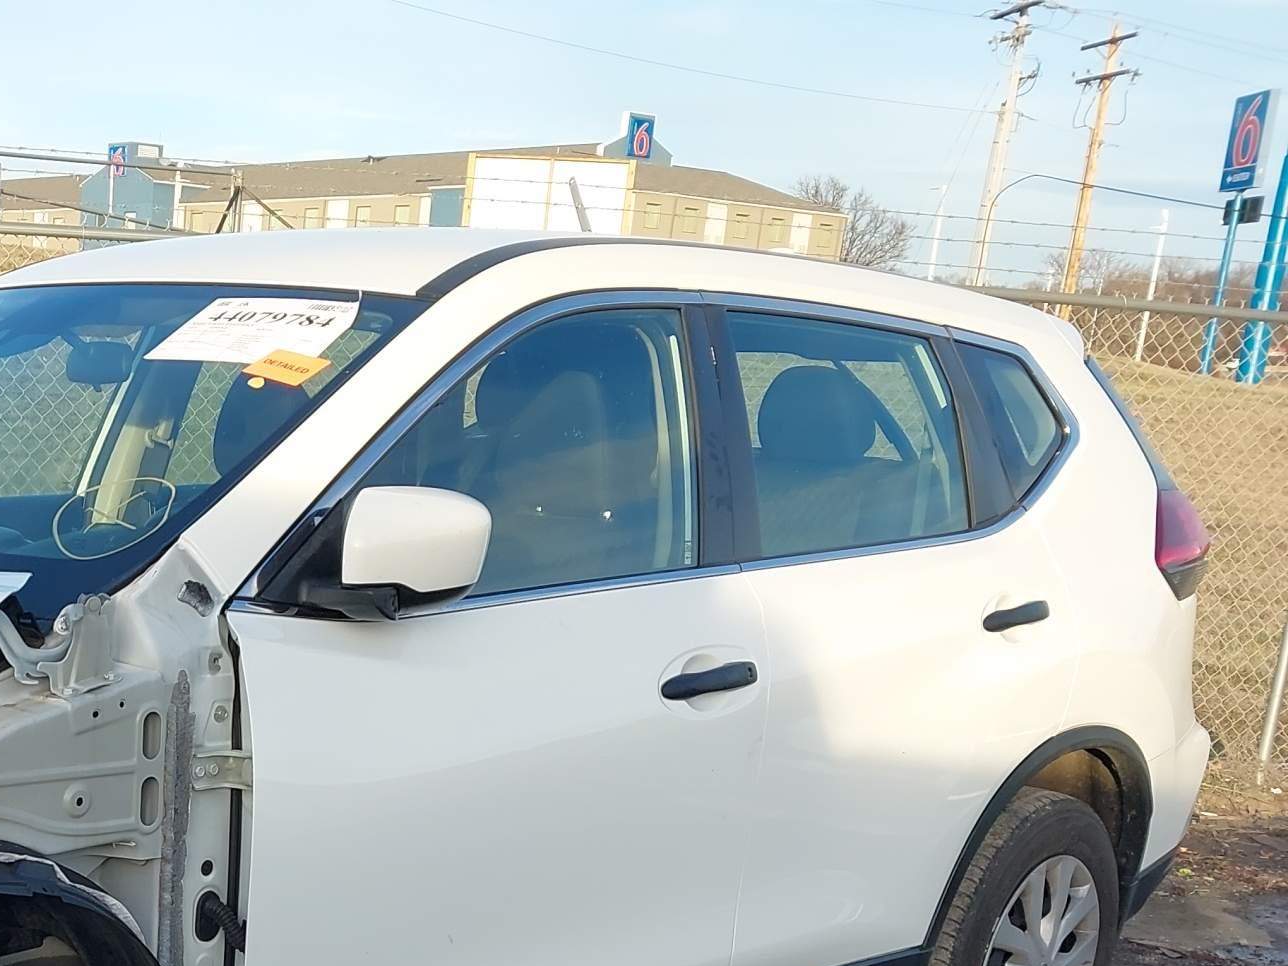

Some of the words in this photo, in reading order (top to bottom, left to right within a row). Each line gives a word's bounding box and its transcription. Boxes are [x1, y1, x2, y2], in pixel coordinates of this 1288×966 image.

[634, 122, 649, 156] 6
[1233, 95, 1263, 168] 6
[208, 310, 336, 328] 44079784
[263, 358, 310, 374] DETAILED
